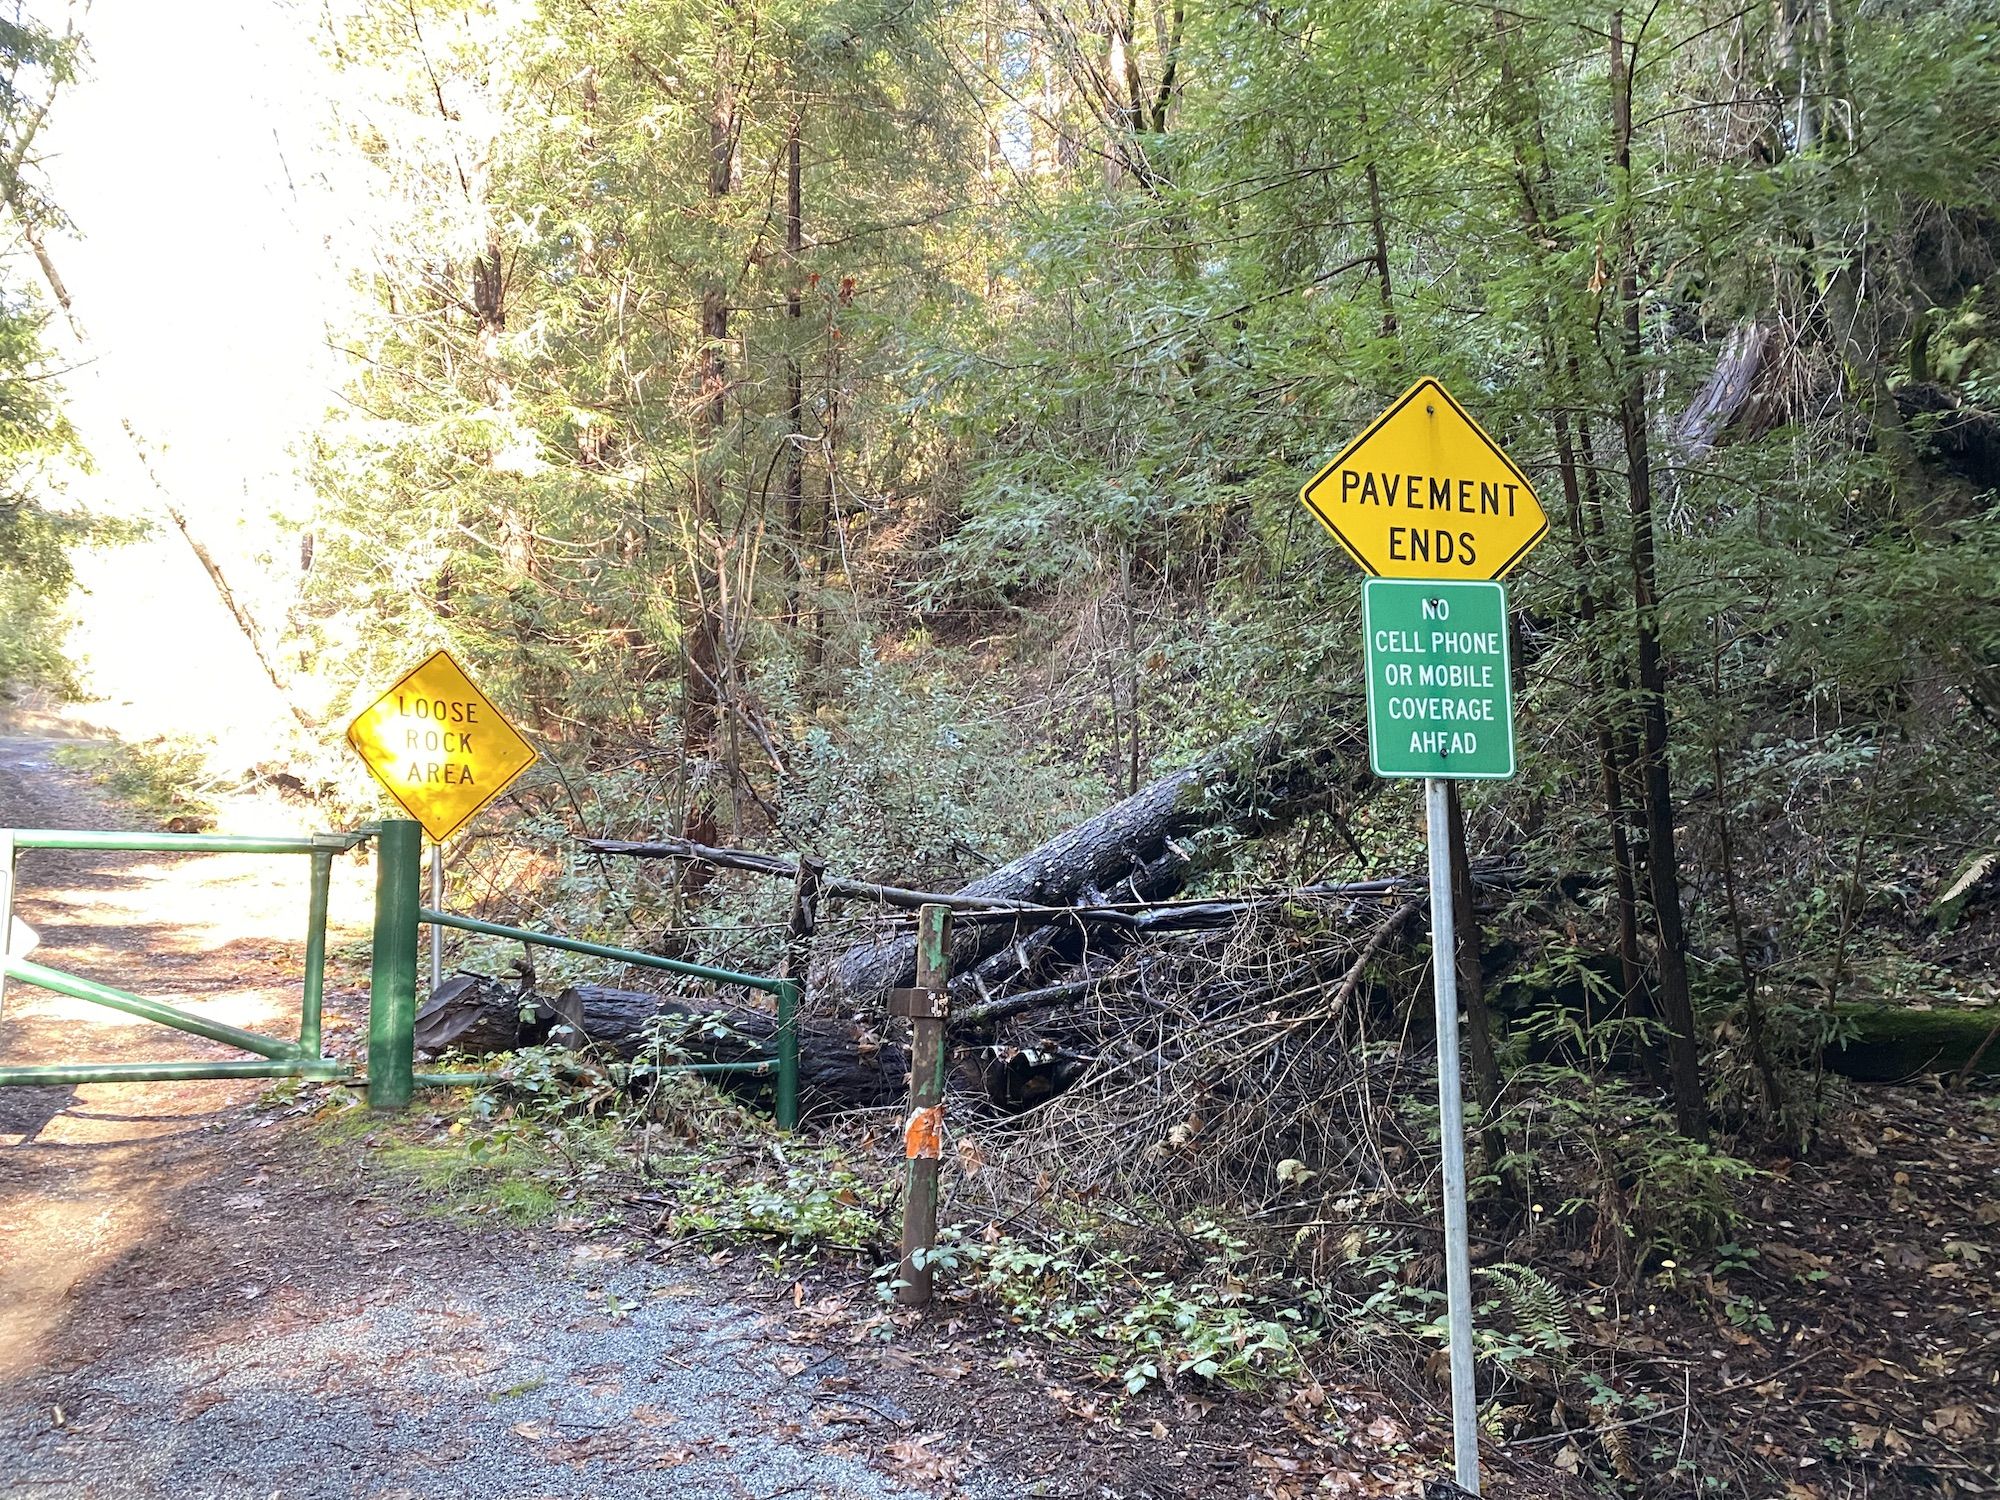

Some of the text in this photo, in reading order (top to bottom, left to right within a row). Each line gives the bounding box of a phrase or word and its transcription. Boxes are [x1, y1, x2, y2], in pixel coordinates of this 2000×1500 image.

[1341, 470, 1519, 517] PAVEMENT
[1389, 527, 1476, 566] ENDS
[1422, 598, 1449, 621] NO
[1375, 630, 1500, 654] CELL PHONE
[1385, 664, 1494, 688] OR MOBILE
[399, 696, 478, 723] LOOSE
[1388, 697, 1494, 721] COVERAGE
[407, 729, 473, 754] ROCK
[1409, 731, 1477, 754] AHEAD
[407, 762, 475, 785] AREA
